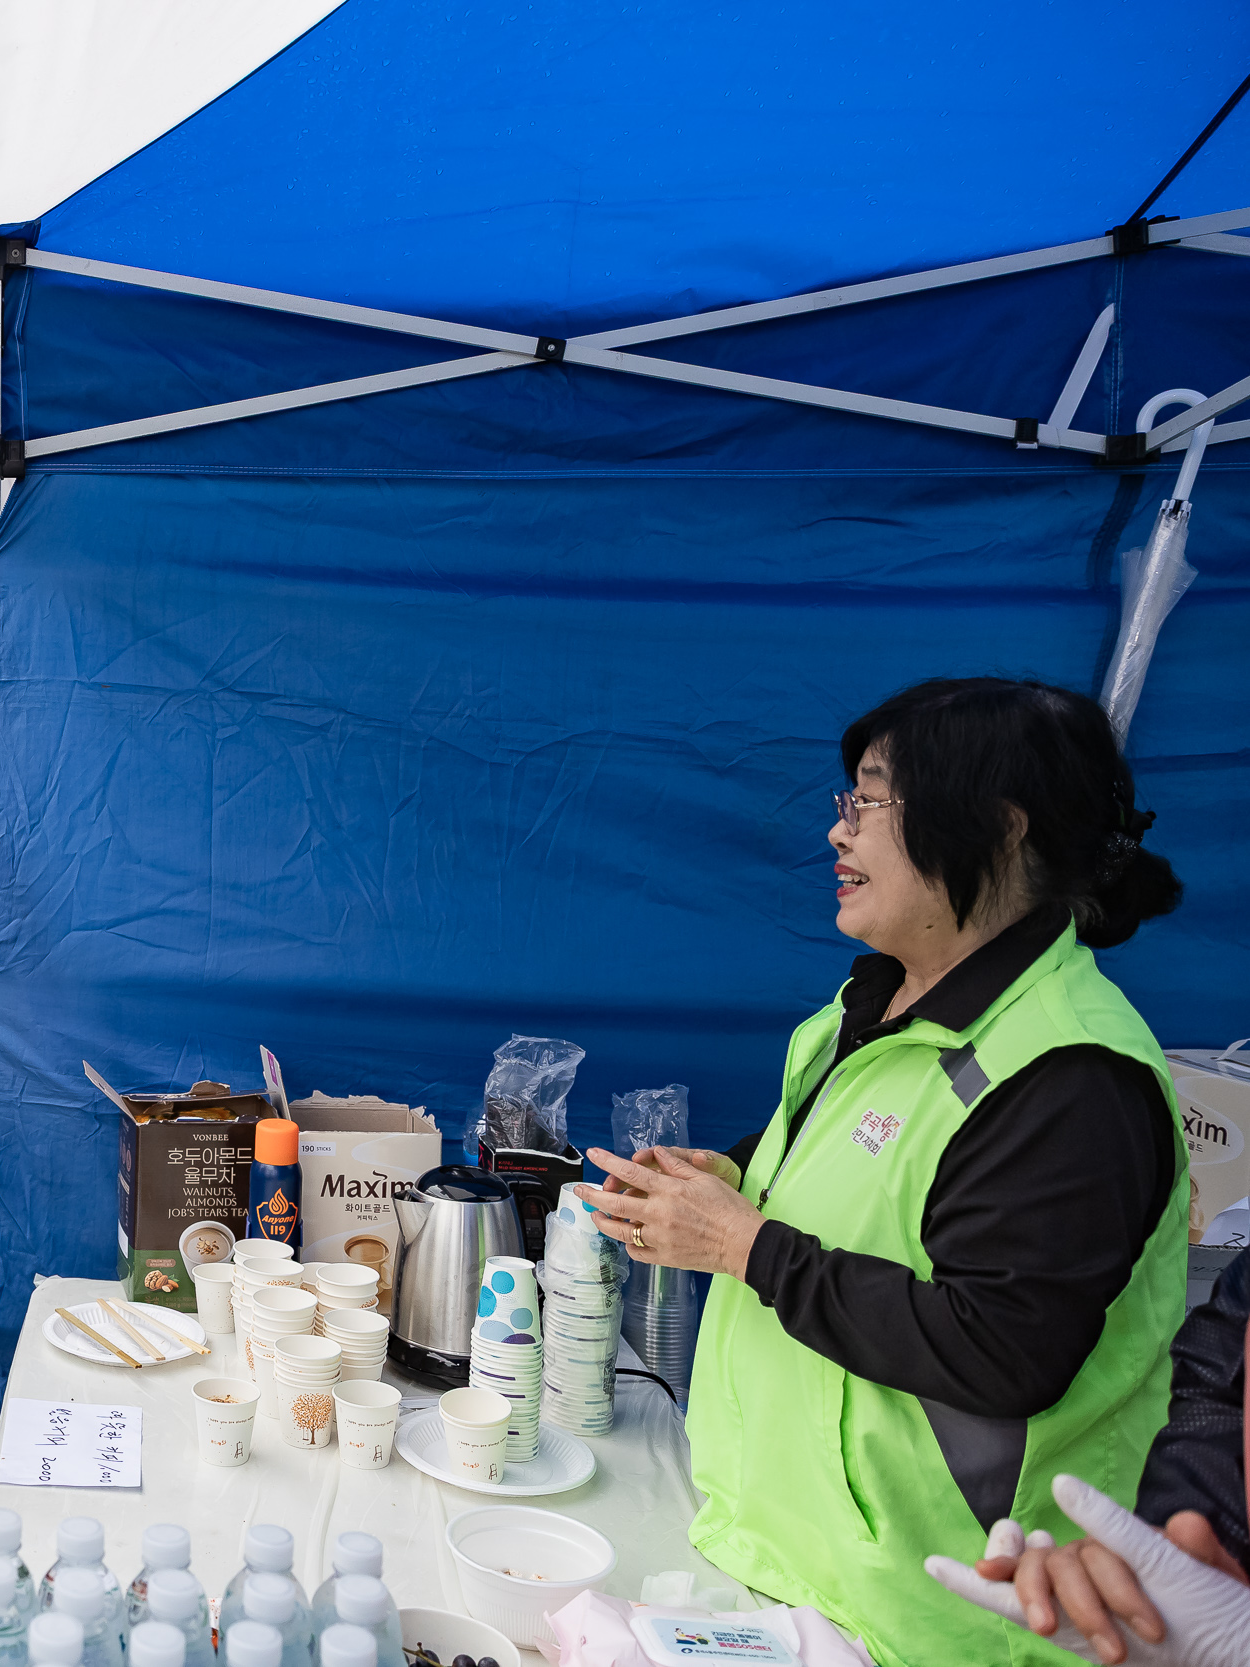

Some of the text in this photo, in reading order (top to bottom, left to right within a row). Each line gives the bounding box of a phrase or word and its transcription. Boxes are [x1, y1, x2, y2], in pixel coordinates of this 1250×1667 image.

[1182, 1106, 1228, 1146] xim
[167, 1147, 252, 1165] 호두아몬드
[184, 1167, 236, 1184] 율무차
[320, 1170, 414, 1199] Maxim
[183, 1187, 236, 1197] WALNUTS,
[185, 1198, 237, 1207] ALMONDS
[345, 1203, 391, 1214] 화이트골드
[168, 1208, 249, 1219] JOB'S TEARS TEA
[261, 1214, 294, 1224] Anyone
[270, 1225, 286, 1236] 119
[93, 1446, 124, 1463] 커피
[38, 1457, 56, 1482] 2000
